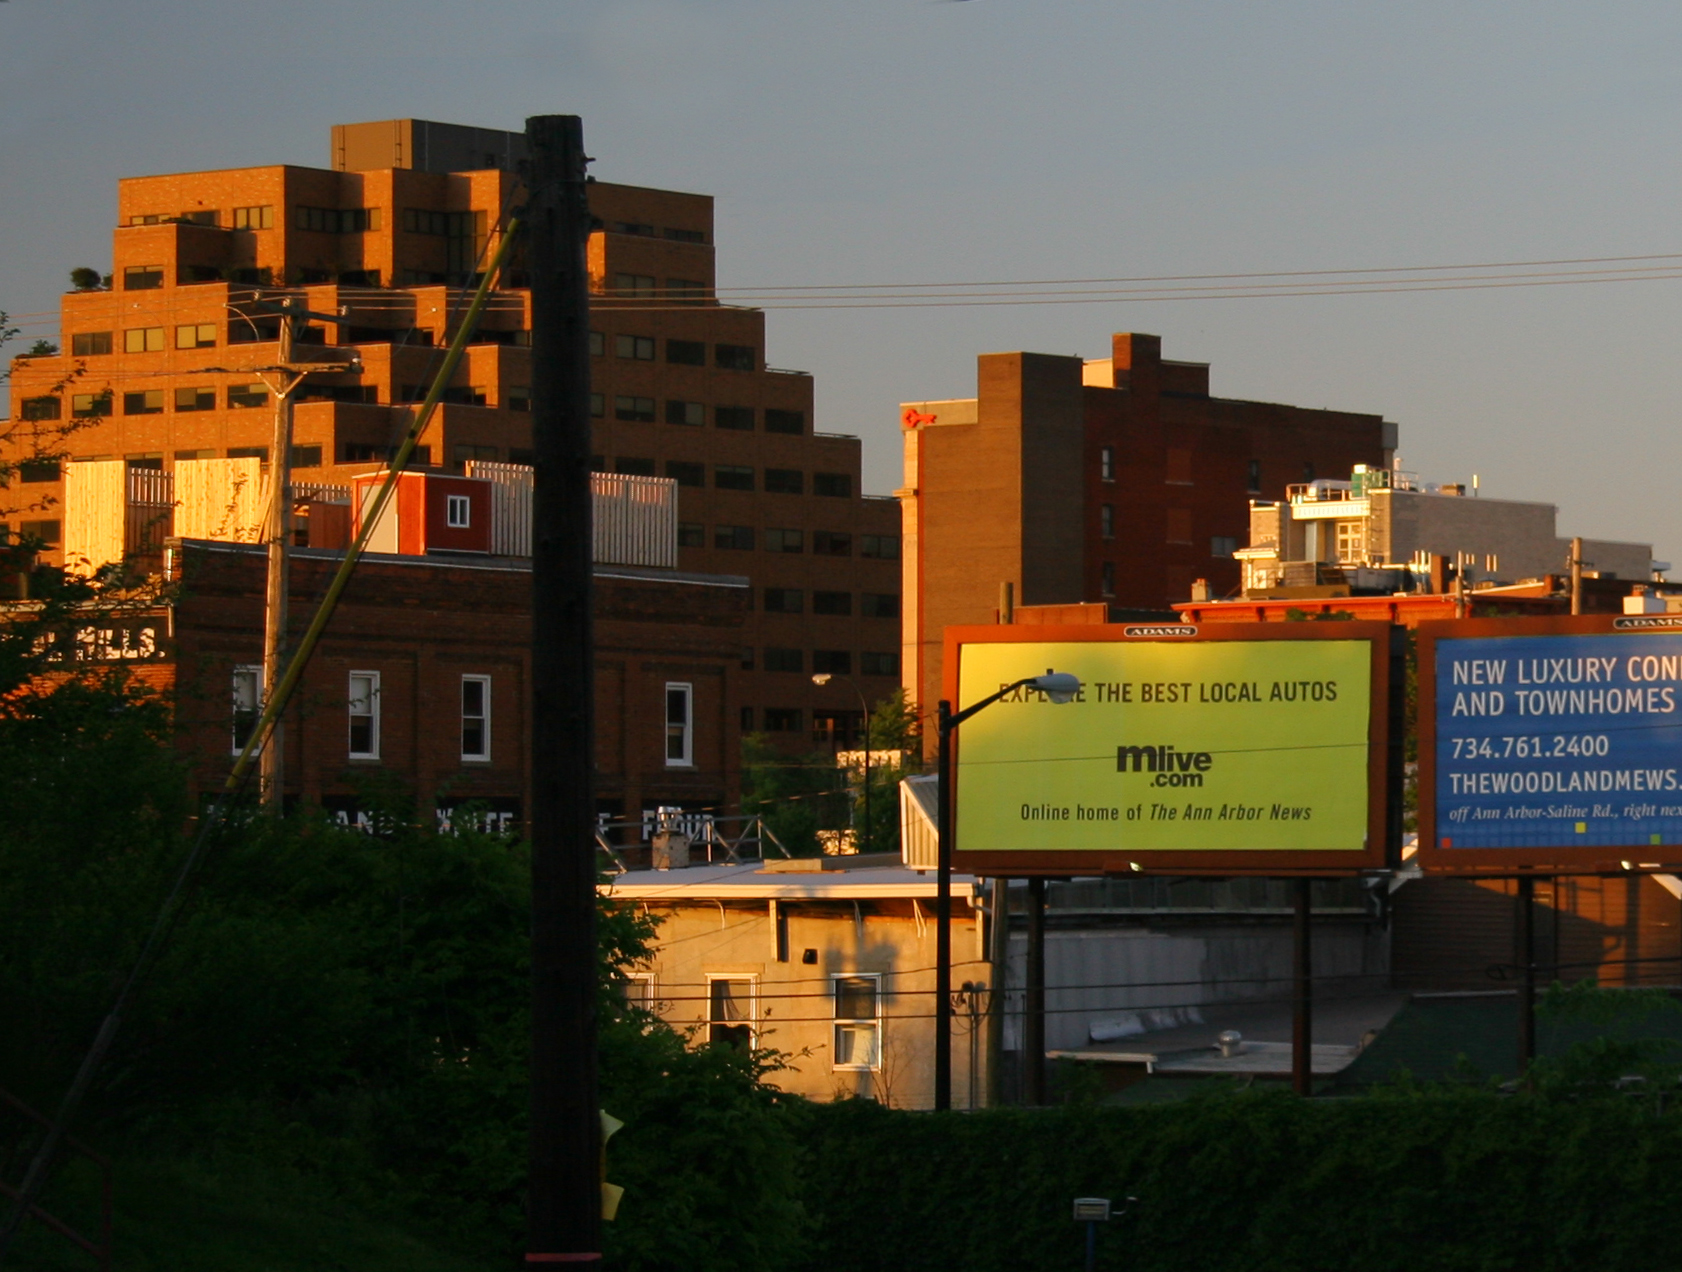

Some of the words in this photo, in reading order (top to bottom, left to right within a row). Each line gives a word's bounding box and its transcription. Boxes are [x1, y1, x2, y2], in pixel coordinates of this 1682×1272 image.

[1453, 660, 1506, 685] NEW
[1518, 657, 1617, 684] LUXURY
[999, 683, 1086, 703] EXPLE
[1094, 683, 1133, 703] THE
[1141, 682, 1192, 703] BEST
[1200, 682, 1261, 703] LOCAL
[1269, 681, 1338, 702] AUTOS
[1452, 691, 1504, 717] AND
[1515, 687, 1675, 715] TOWNHOMES
[1116, 745, 1212, 772] mlive
[1452, 736, 1609, 759] 734.761.2400
[1150, 773, 1203, 787] .com
[1021, 804, 1069, 820] Online
[1077, 804, 1118, 820] home
[1127, 804, 1142, 820] of
[1150, 804, 1177, 820] The
[1182, 804, 1212, 820] Ann
[1218, 803, 1264, 820] Arbor
[1269, 804, 1311, 820] News
[1449, 806, 1470, 822] off
[1472, 807, 1500, 819] Ann
[1504, 805, 1588, 819] Arbor-Saline
[1592, 804, 1619, 818] Rd.,
[1622, 804, 1656, 820] right
